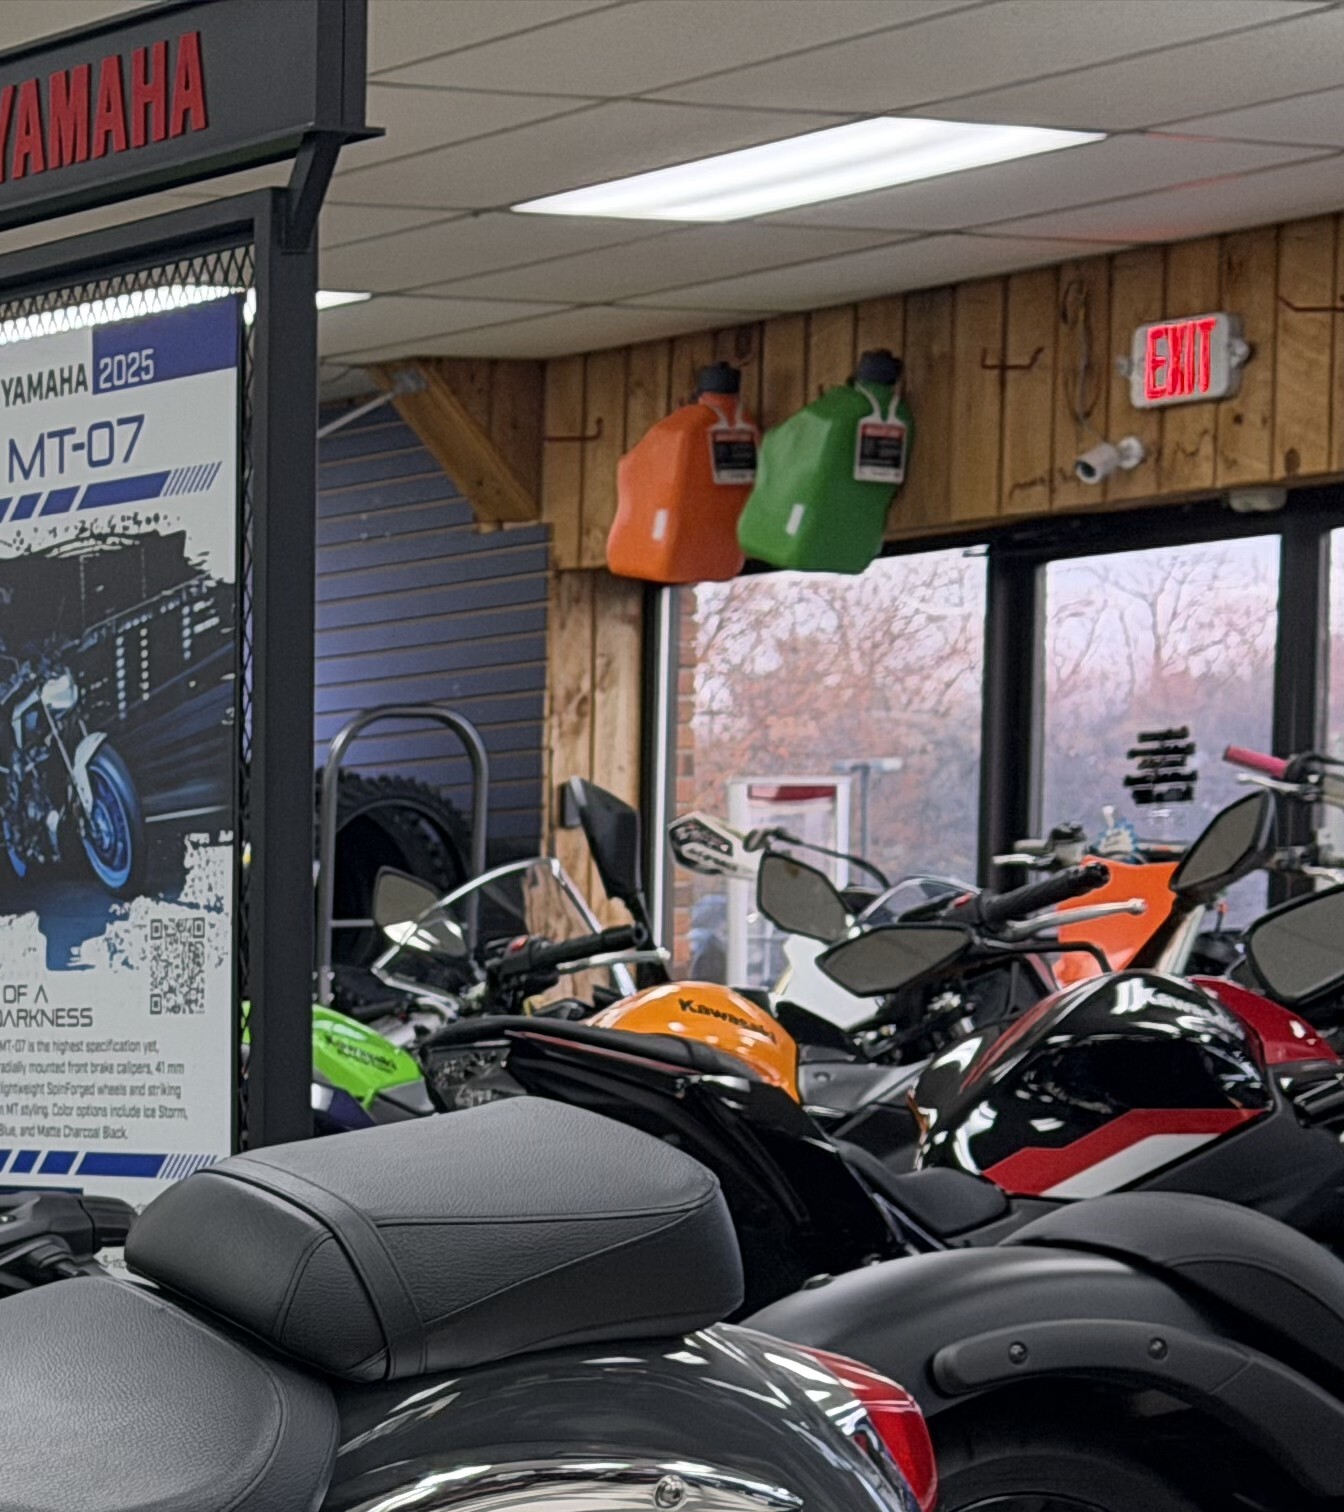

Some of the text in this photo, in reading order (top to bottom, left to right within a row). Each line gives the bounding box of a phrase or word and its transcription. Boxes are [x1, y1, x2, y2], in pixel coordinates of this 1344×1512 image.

[1, 348, 154, 407] YAMAHA 2025
[1145, 317, 1216, 400] EXIT
[8, 414, 145, 483] MT-07
[3, 985, 30, 1004] OF
[679, 998, 777, 1044] Kawasaki
